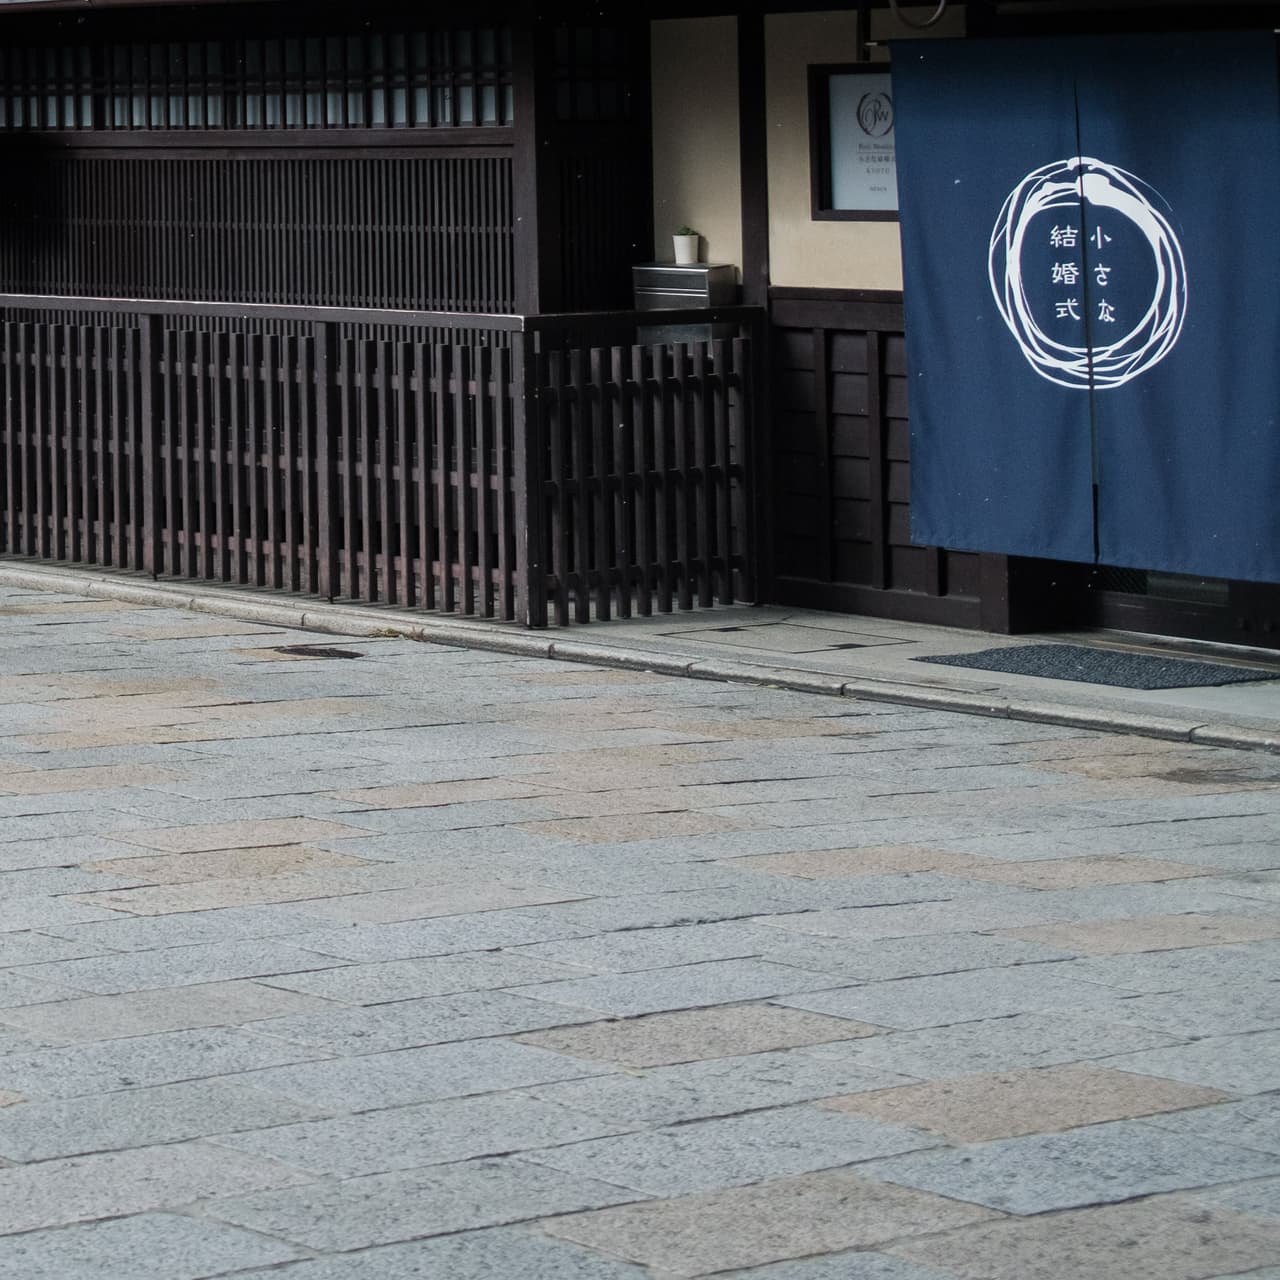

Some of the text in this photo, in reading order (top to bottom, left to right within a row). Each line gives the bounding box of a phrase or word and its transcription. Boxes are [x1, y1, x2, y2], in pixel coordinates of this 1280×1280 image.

[1049, 225, 1081, 321] 結婚式
[1090, 226, 1115, 322] 小さな
